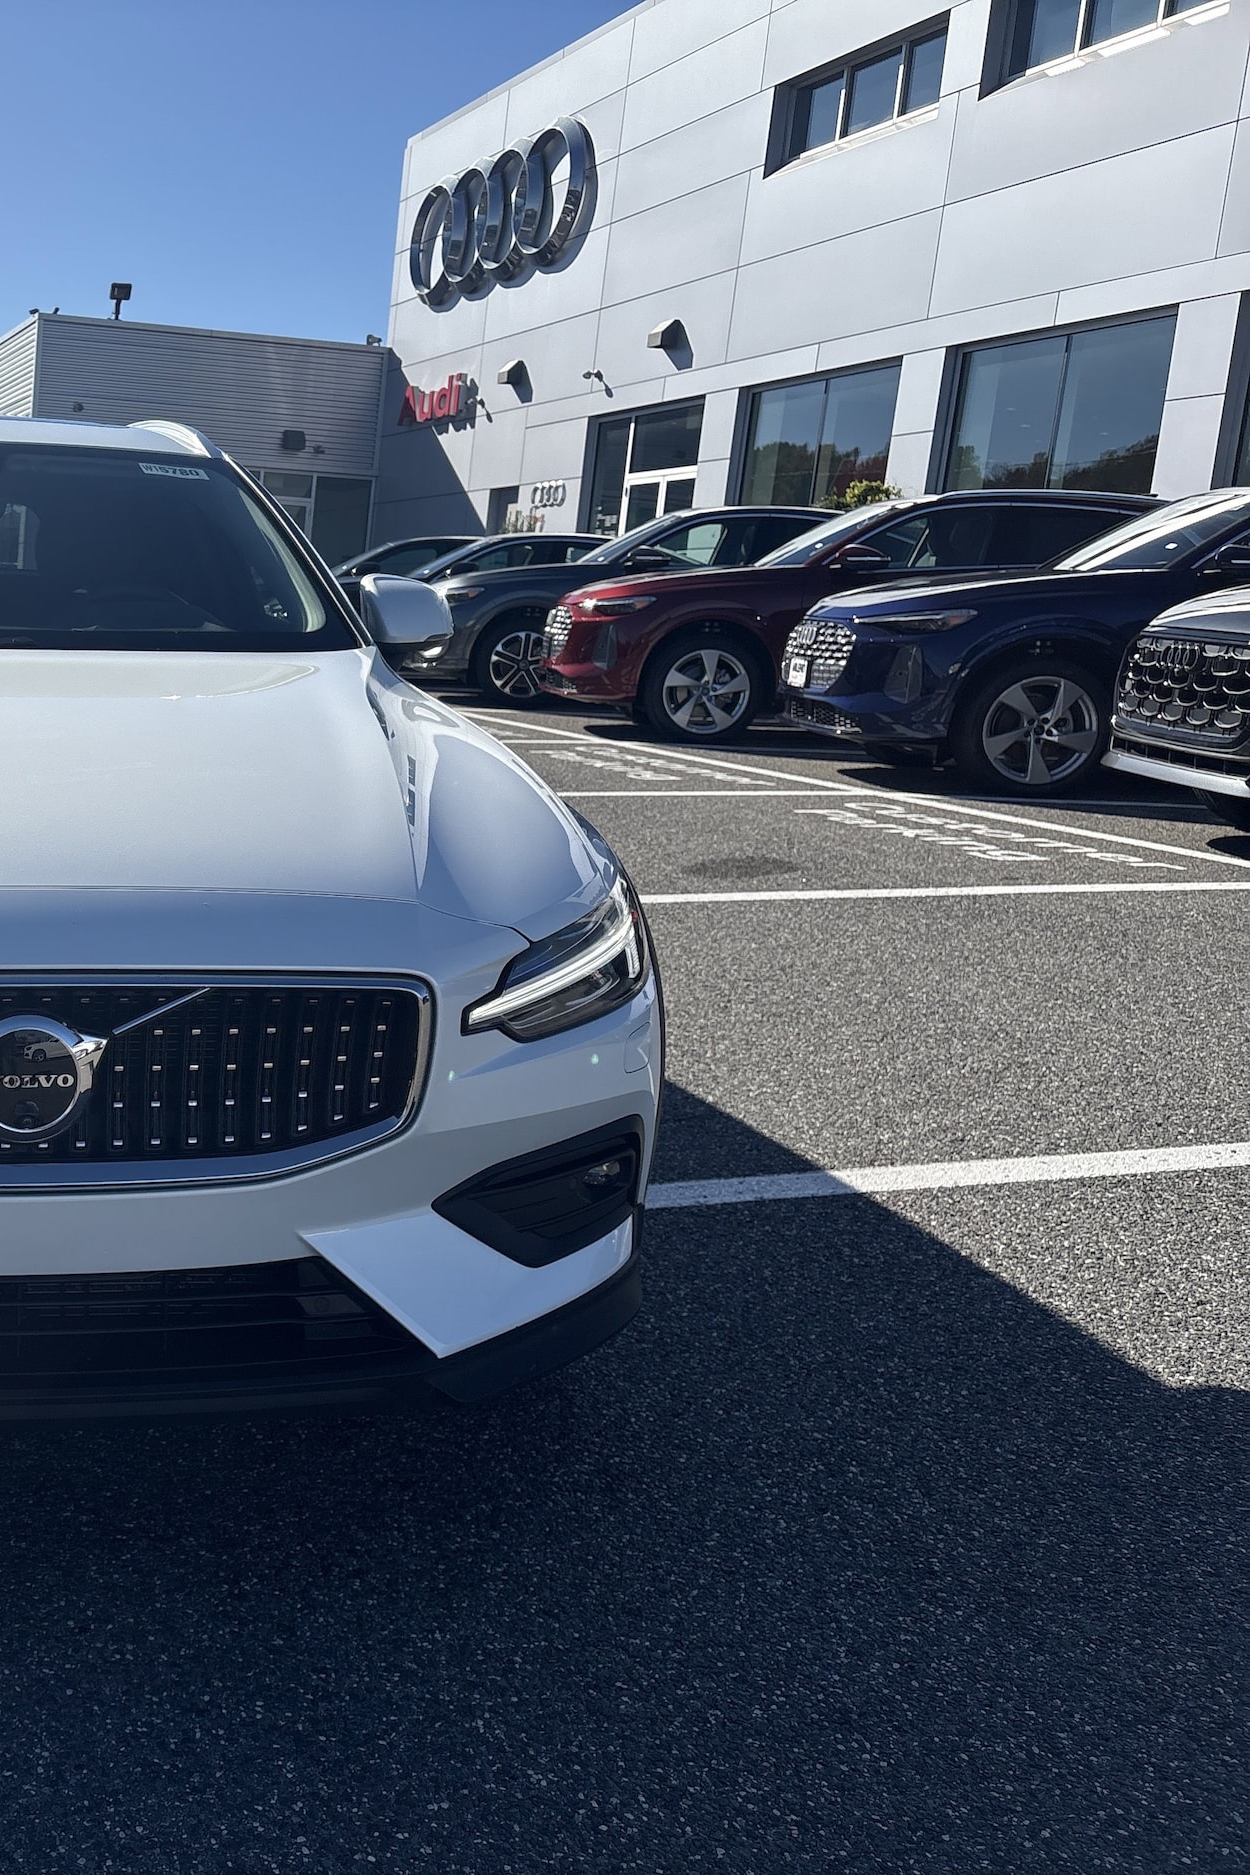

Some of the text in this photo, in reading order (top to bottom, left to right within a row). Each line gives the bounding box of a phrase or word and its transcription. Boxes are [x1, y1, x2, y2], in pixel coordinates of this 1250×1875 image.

[397, 373, 463, 426] Audi
[793, 809, 1052, 861] Parking
[844, 802, 1188, 870] Customer
